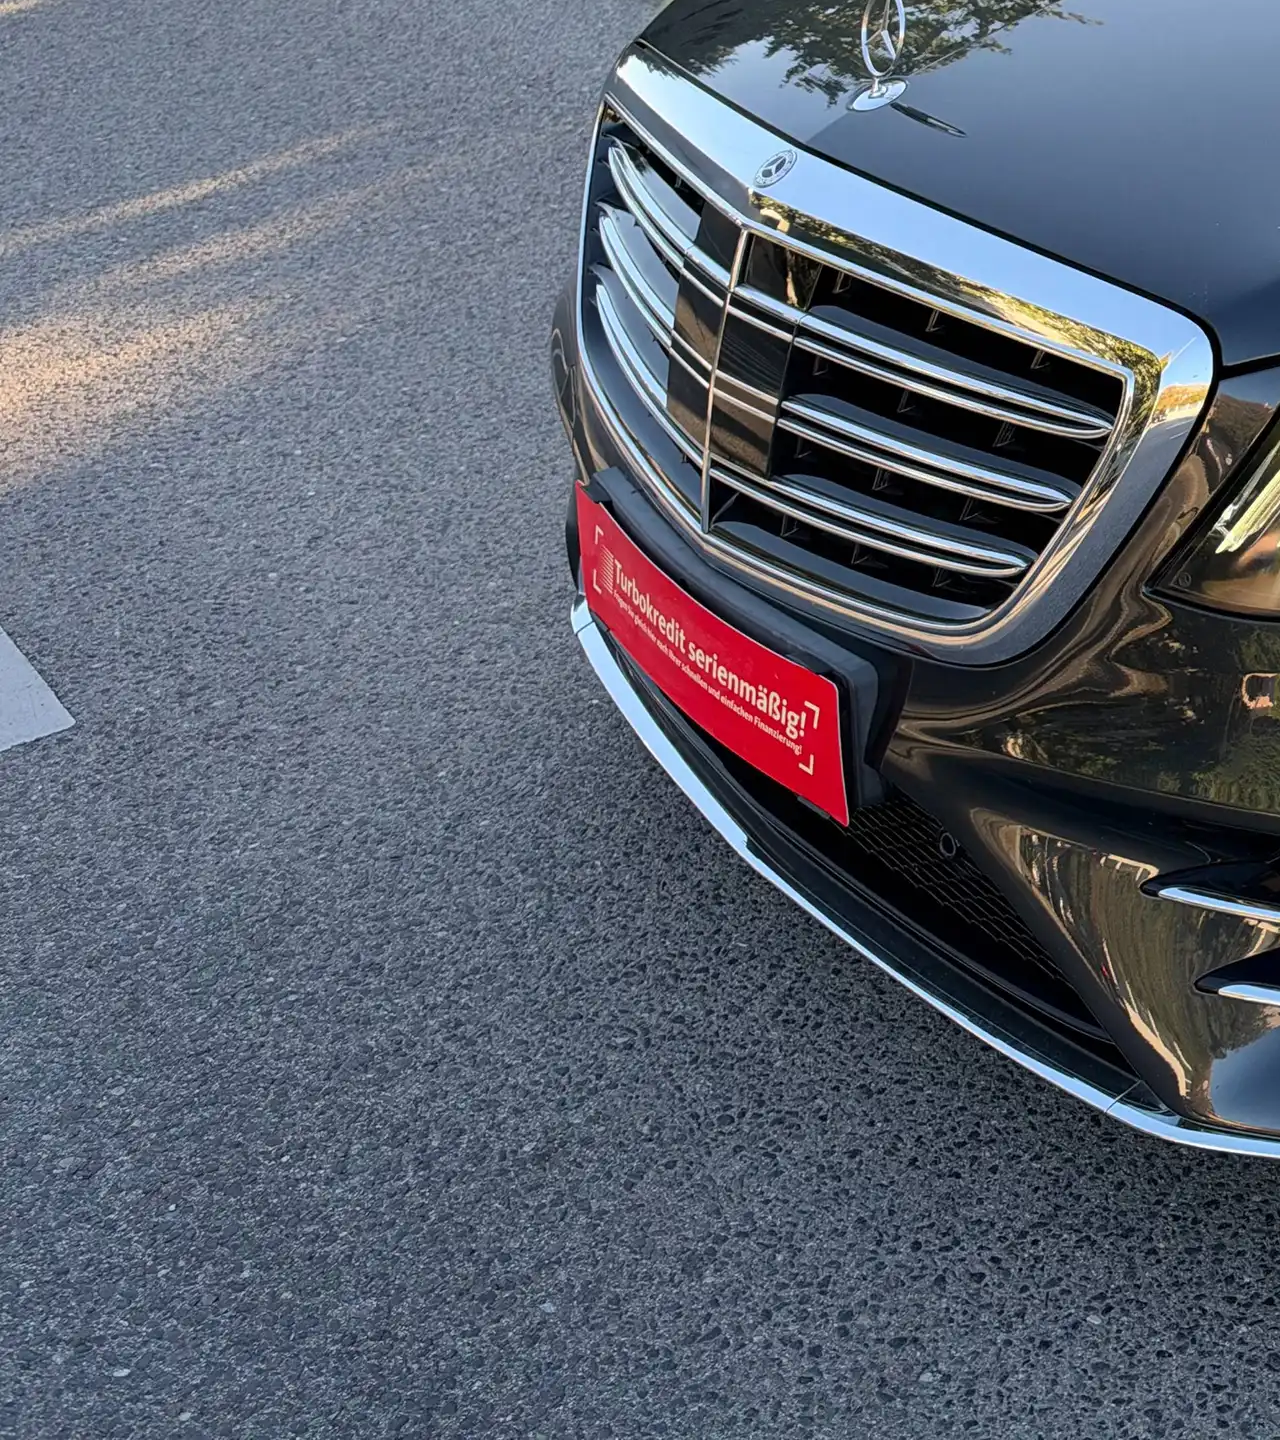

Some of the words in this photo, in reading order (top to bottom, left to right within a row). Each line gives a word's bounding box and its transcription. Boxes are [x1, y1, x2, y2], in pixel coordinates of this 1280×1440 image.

[614, 558, 687, 655] Turbokredit
[688, 641, 807, 740] serienmäßig!
[681, 663, 709, 692] schnellen
[708, 685, 721, 702] und
[720, 695, 754, 724] einfachen
[754, 715, 803, 757] Finanzierung!
